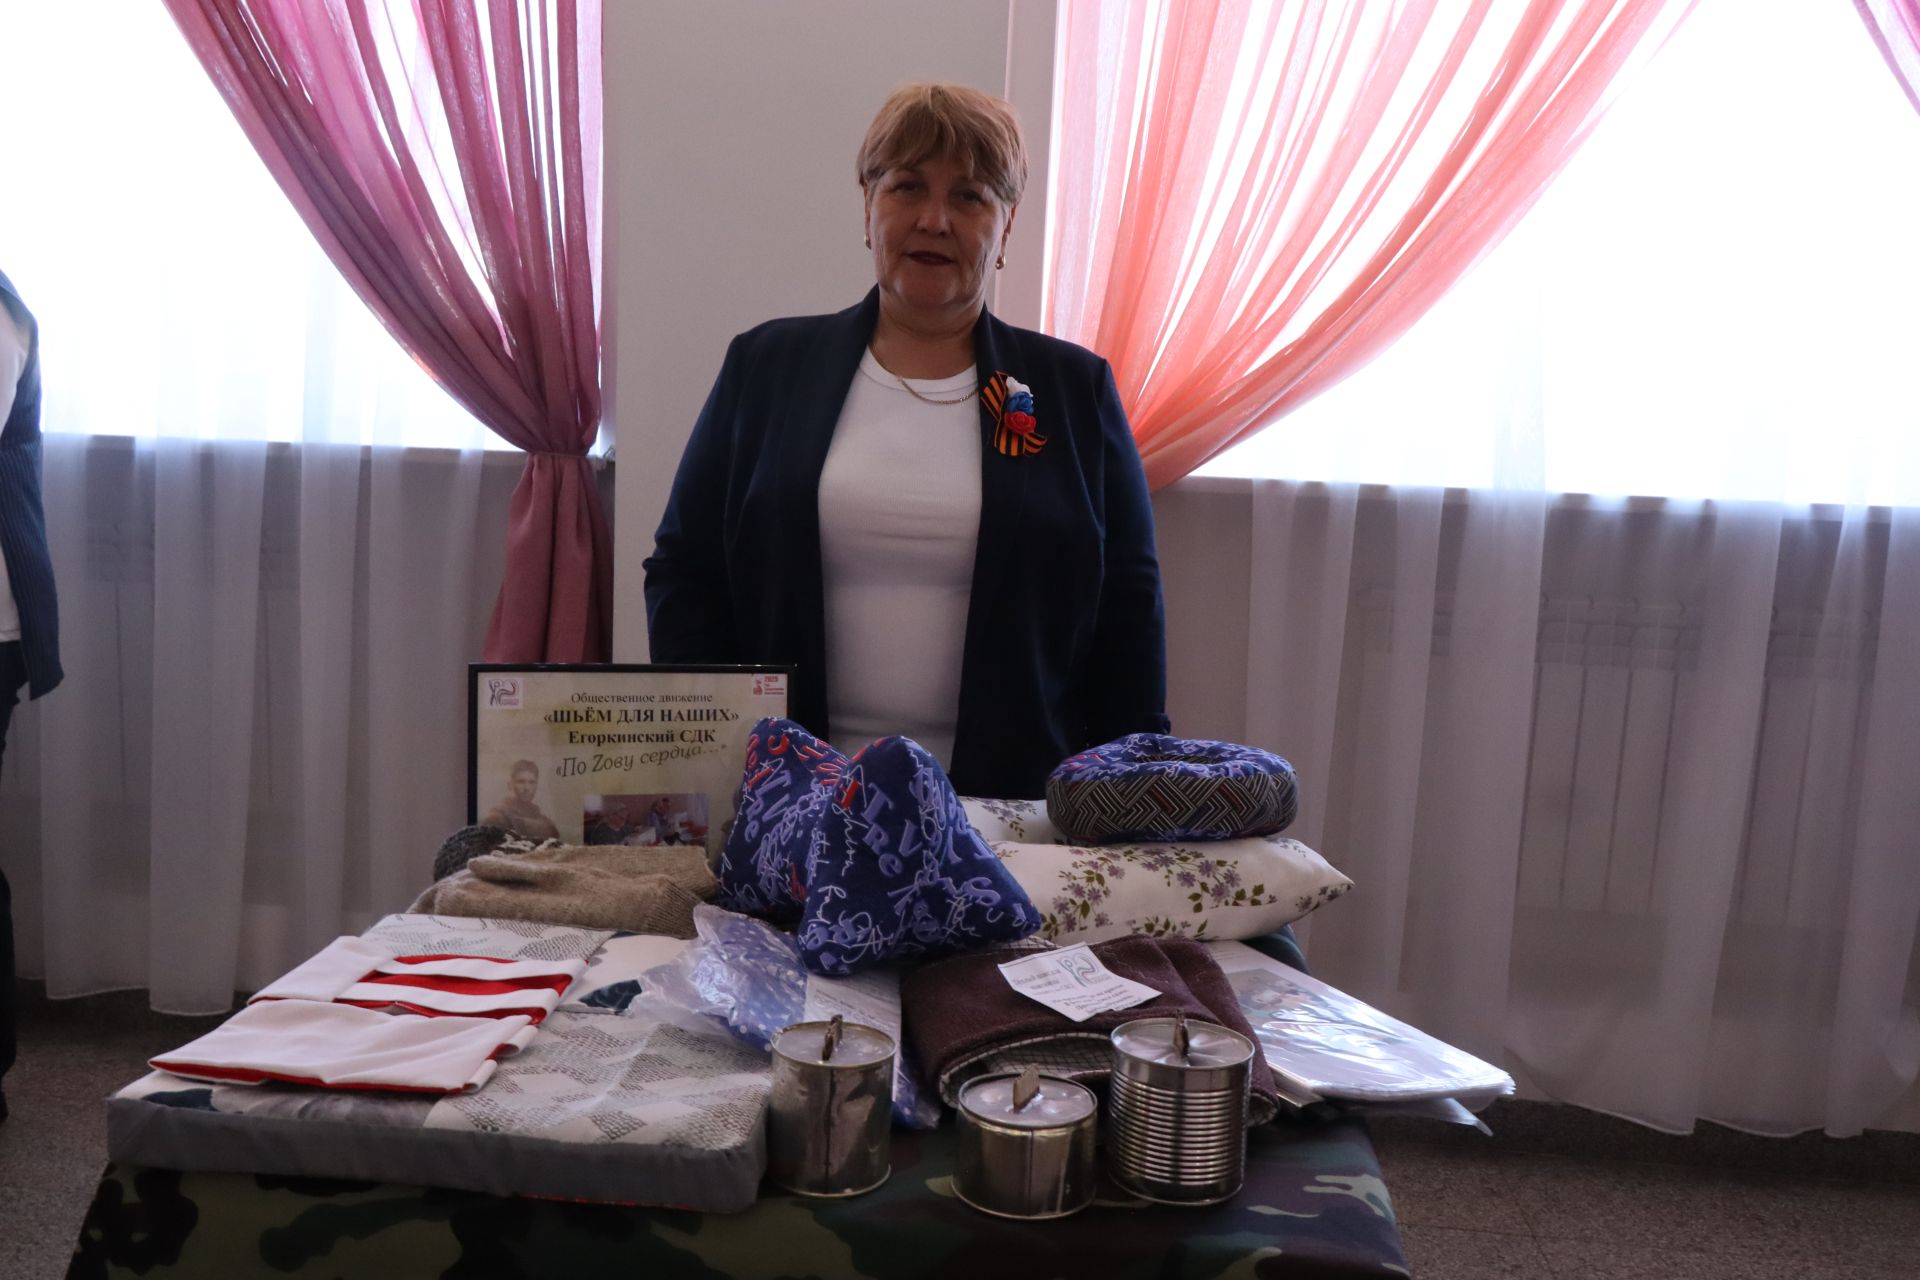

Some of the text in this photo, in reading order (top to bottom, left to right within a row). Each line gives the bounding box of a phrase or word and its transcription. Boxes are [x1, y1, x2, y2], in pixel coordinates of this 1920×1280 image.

[571, 692, 713, 705] Общественное движение
[543, 707, 739, 725] «ШЬЁМ ДЛЯ НАШИХ»
[568, 729, 716, 747] Егоркинский СДК
[591, 753, 634, 772] Zову
